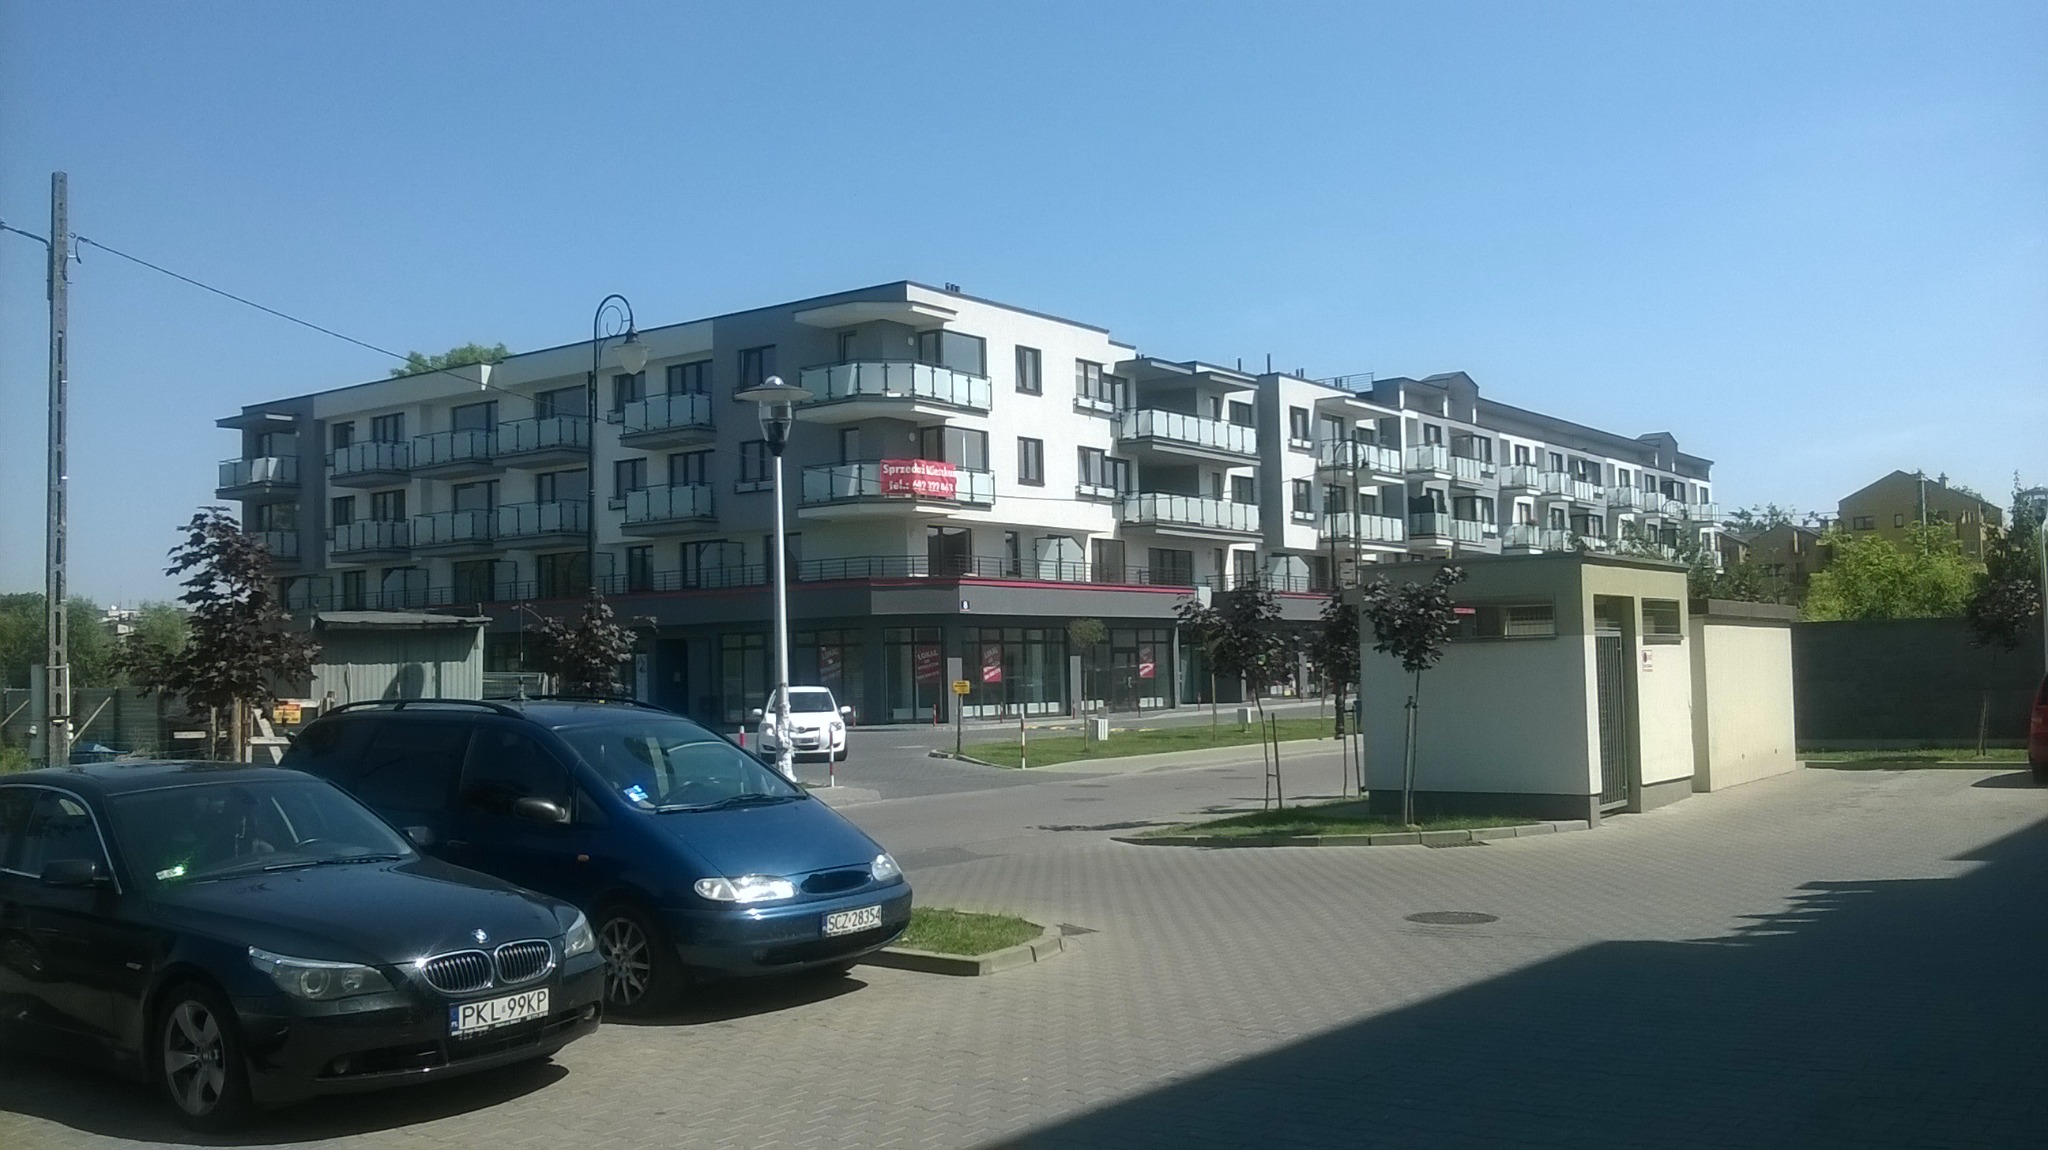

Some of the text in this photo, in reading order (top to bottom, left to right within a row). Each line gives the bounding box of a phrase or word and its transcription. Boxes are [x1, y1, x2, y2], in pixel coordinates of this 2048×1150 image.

[963, 600, 968, 609] 8
[829, 913, 848, 931] SCZ
[851, 907, 881, 927] 28354
[462, 991, 546, 1027] PKL 99KP
